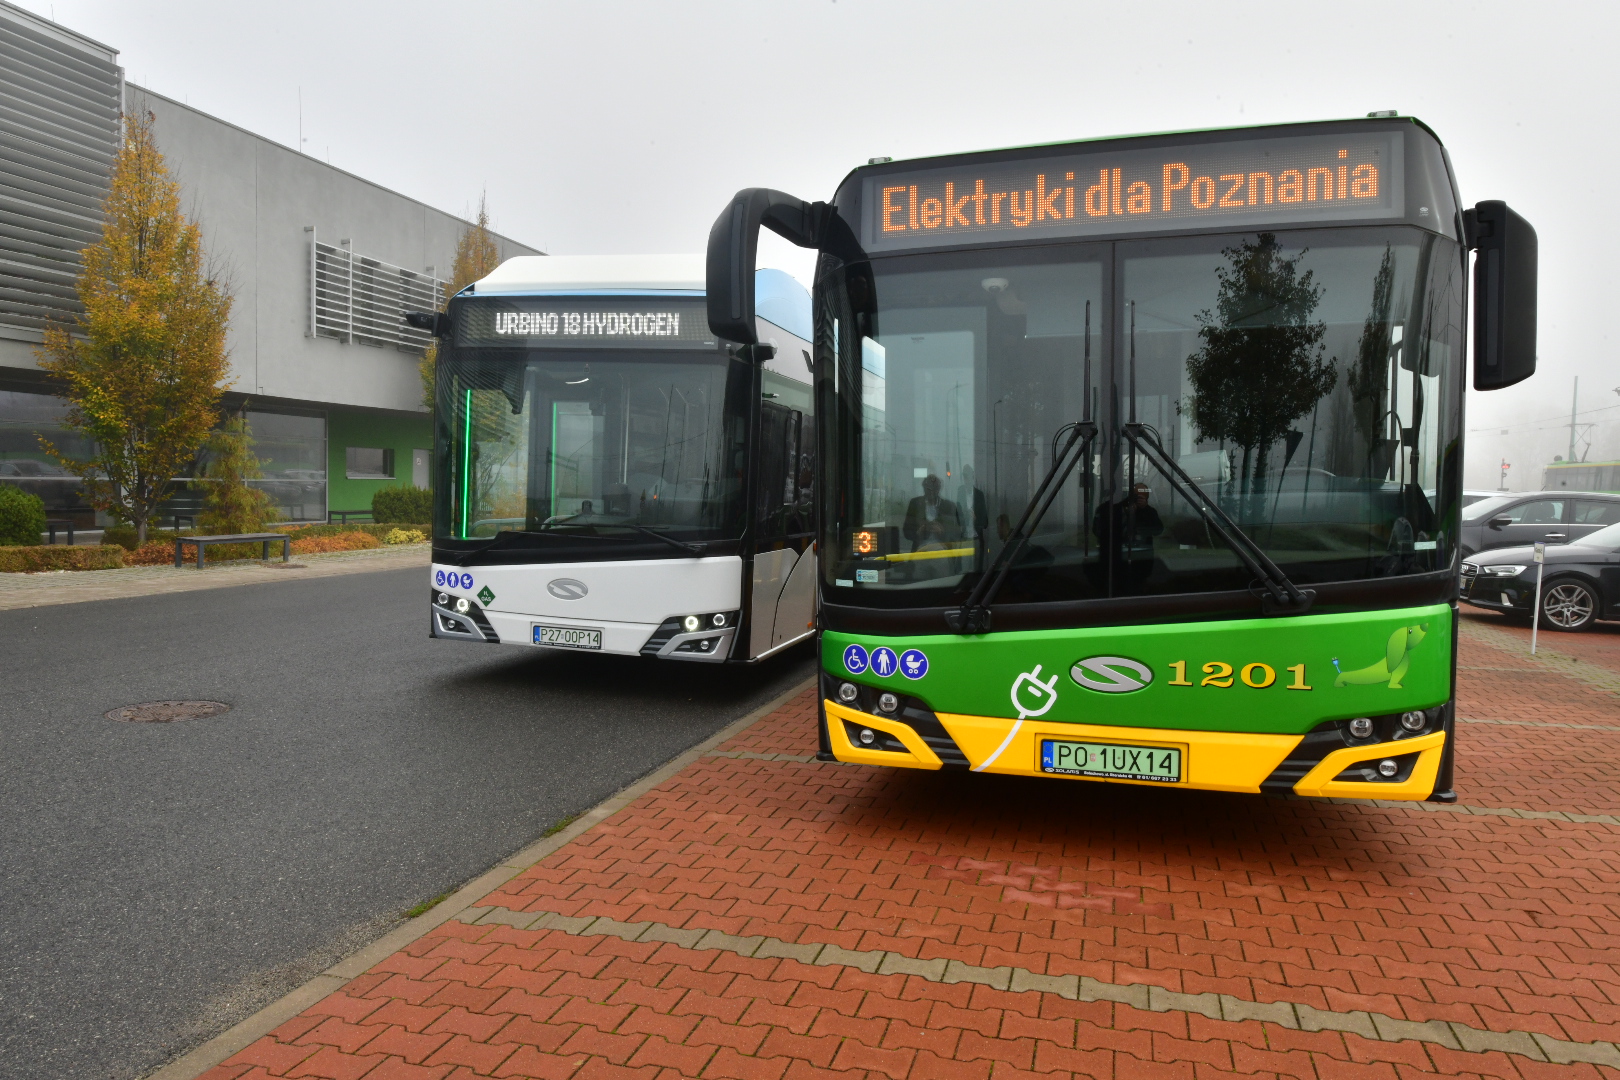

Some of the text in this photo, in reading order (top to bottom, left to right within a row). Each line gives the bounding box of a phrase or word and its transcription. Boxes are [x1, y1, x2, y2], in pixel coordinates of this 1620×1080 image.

[881, 149, 1380, 232] Elektryki dla Poznania
[495, 312, 680, 336] URBINO 18 HYDROGEN
[858, 531, 872, 553] 3
[1167, 660, 1313, 691] 1201
[1043, 756, 1053, 764] PL
